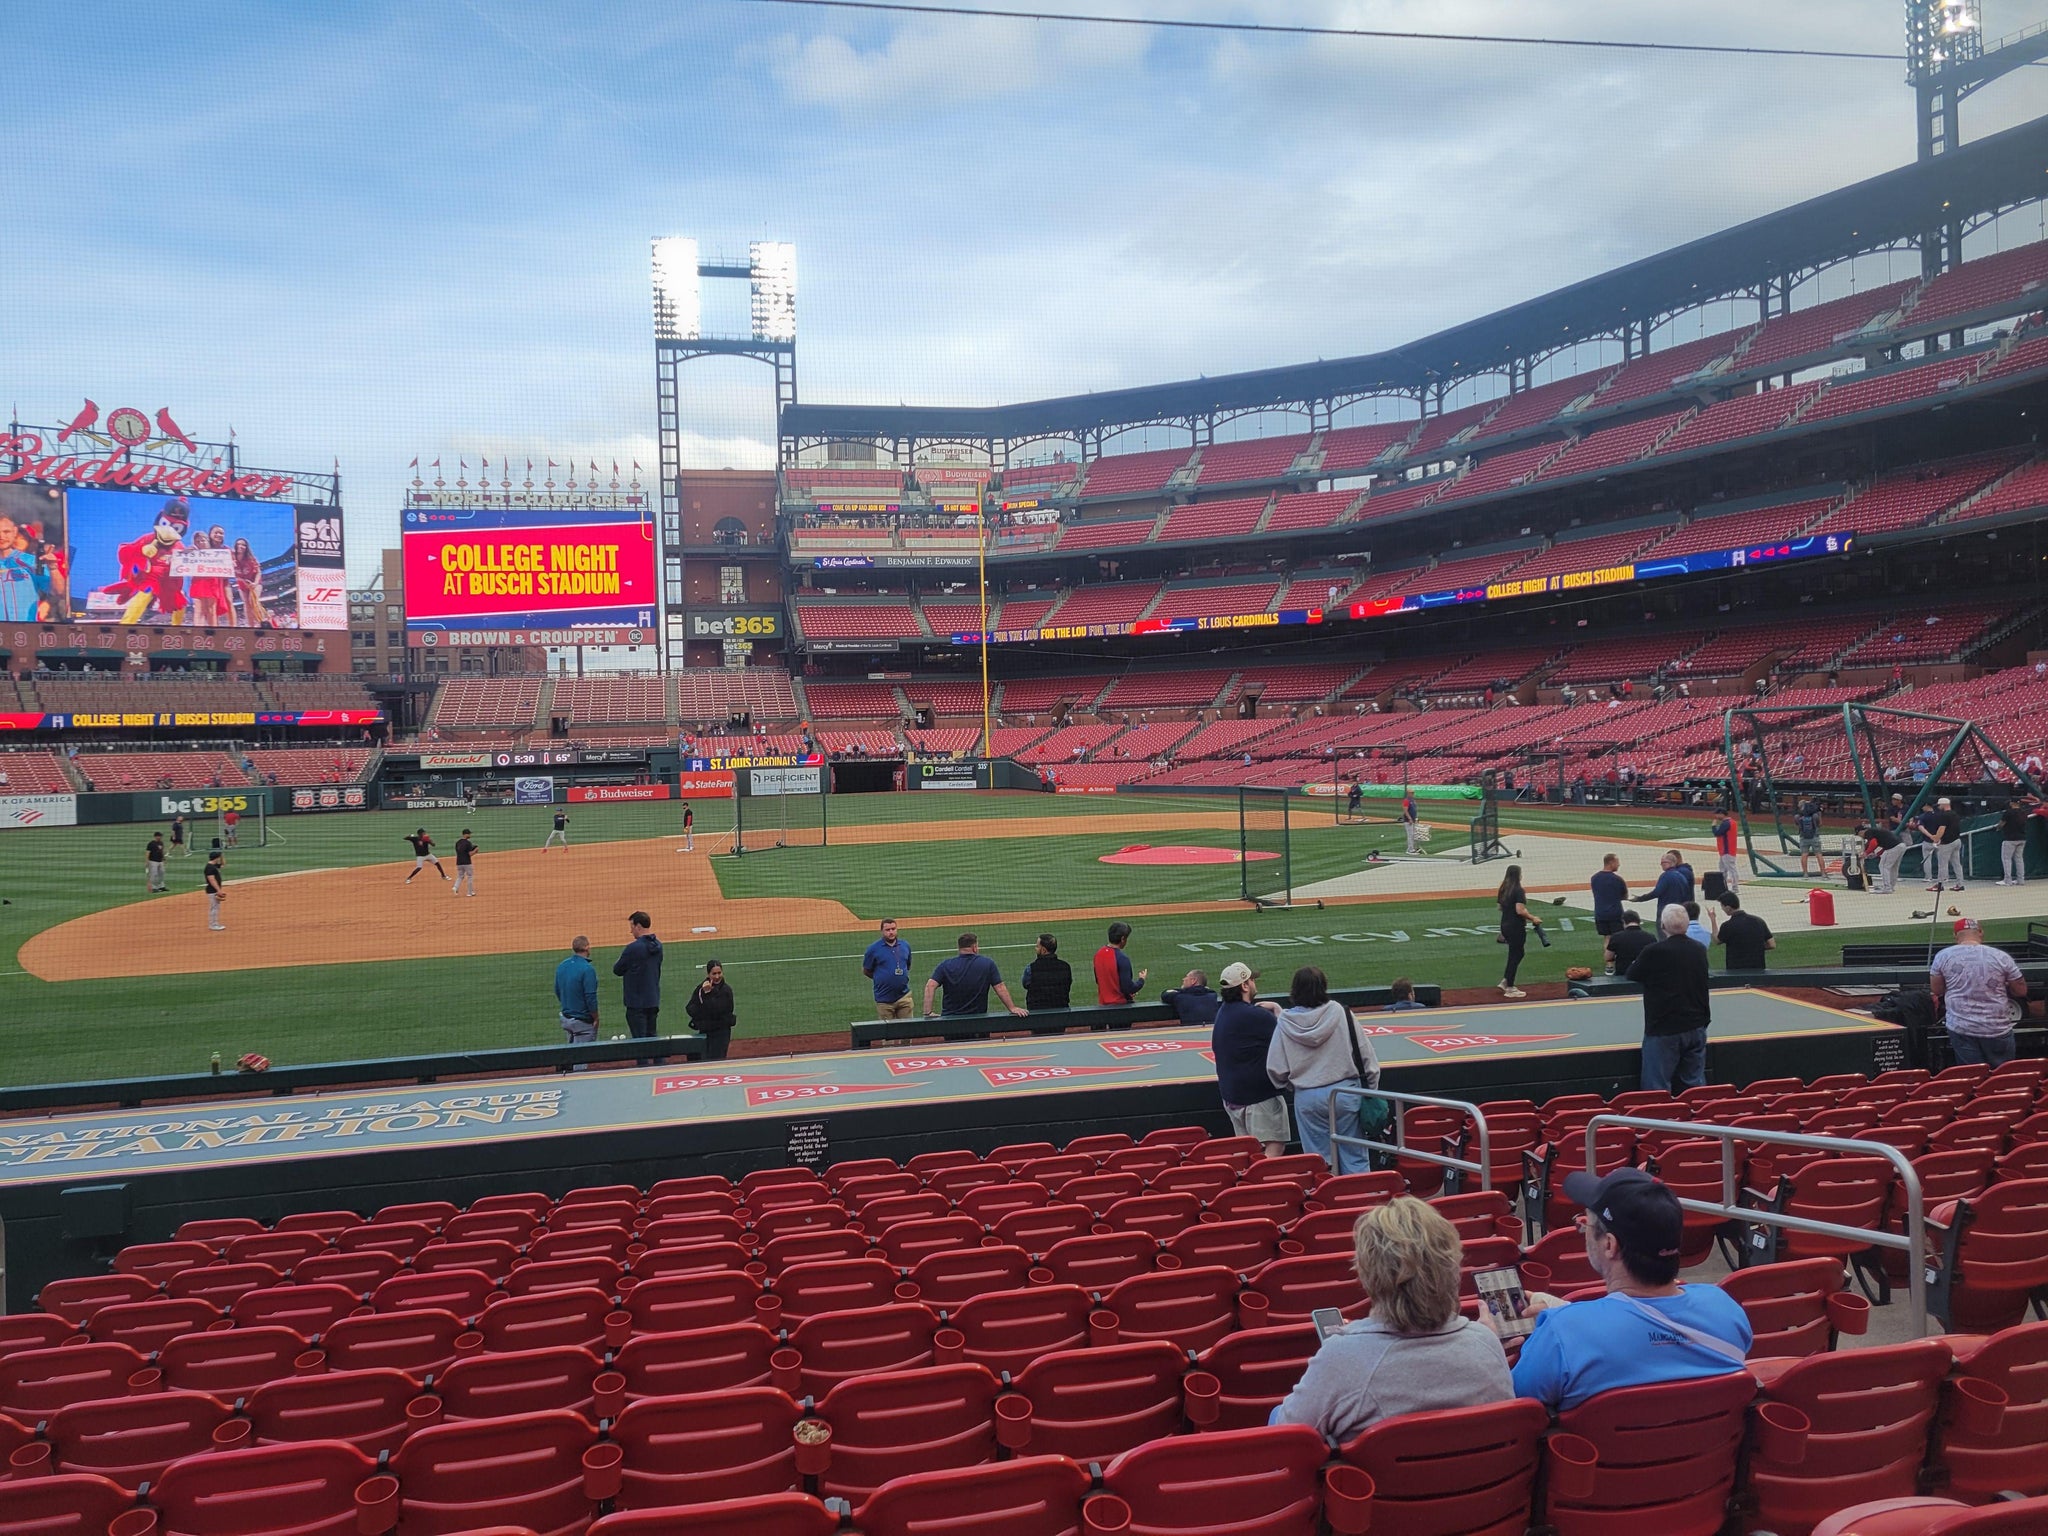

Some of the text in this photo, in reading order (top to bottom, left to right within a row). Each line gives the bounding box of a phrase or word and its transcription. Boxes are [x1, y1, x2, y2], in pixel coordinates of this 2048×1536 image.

[0, 433, 293, 498] Budweiser
[945, 470, 987, 478] BUDWEISER
[430, 492, 628, 506] WORLD CHAMPIONS
[299, 518, 340, 542] stl
[300, 540, 340, 550] TODAY
[440, 544, 619, 572] COLLEGE NIGHT
[844, 558, 866, 566] Cardinals
[444, 572, 620, 595] AT BUSCH STADIUM
[1486, 564, 1634, 599] COLLEGE NIGHT AT BUSCH STADIUM
[694, 616, 775, 634] bet365
[1198, 613, 1279, 629] ST. LOUIS CARDINALS
[449, 632, 510, 645] BROWN
[515, 634, 525, 644] &
[529, 630, 616, 644] CROUPPEN
[1040, 629, 1055, 639] FOR
[1056, 628, 1070, 638] THE
[1072, 626, 1086, 636] LOU
[15, 632, 26, 647] 9
[39, 632, 57, 648] 10
[69, 633, 87, 648] 14
[98, 633, 116, 648] 17
[127, 634, 149, 649] 20
[162, 635, 183, 650] 23
[193, 636, 215, 650] 24
[224, 636, 246, 651] 42
[255, 637, 276, 651] 45
[282, 638, 302, 652] 85
[72, 712, 255, 726] COLLEGE NIGHT AT BUSCH STADIUM
[426, 754, 486, 765] Schnucks
[514, 753, 571, 764] 5:30 65°
[710, 755, 797, 770] ST. LOUIS CARDINALS
[523, 780, 545, 789] Ford
[764, 774, 818, 782] PERFICIENT
[600, 789, 654, 799] Budweiser
[161, 796, 248, 814] bet365
[1110, 1042, 1183, 1054] 1985
[1423, 1035, 1499, 1047] 2013
[894, 1057, 970, 1070] 1943
[992, 1068, 1072, 1080] 1968
[662, 1075, 743, 1090] 1928
[757, 1086, 840, 1100] 1930
[318, 1090, 562, 1120] LEAGUE
